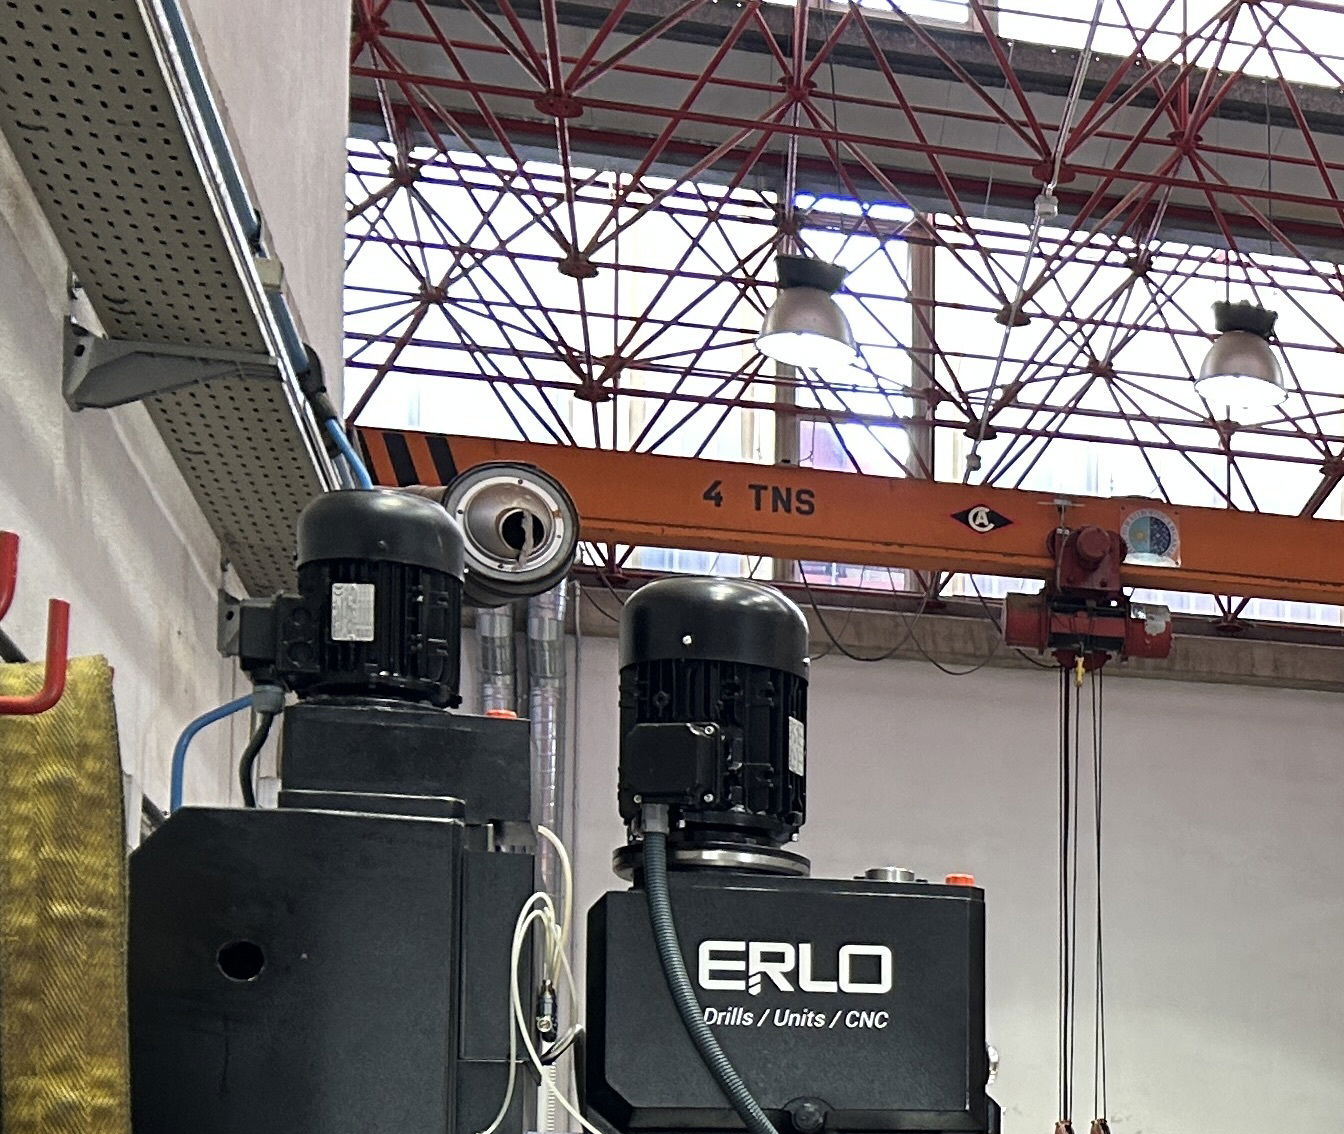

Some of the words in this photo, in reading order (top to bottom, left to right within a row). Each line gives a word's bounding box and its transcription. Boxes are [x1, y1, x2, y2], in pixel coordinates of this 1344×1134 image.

[703, 480, 723, 508] 4
[748, 484, 815, 515] TNS
[698, 940, 892, 996] ERLO
[704, 1006, 754, 1027] Drills
[773, 1008, 826, 1028] Units
[845, 1010, 890, 1029] CNC
